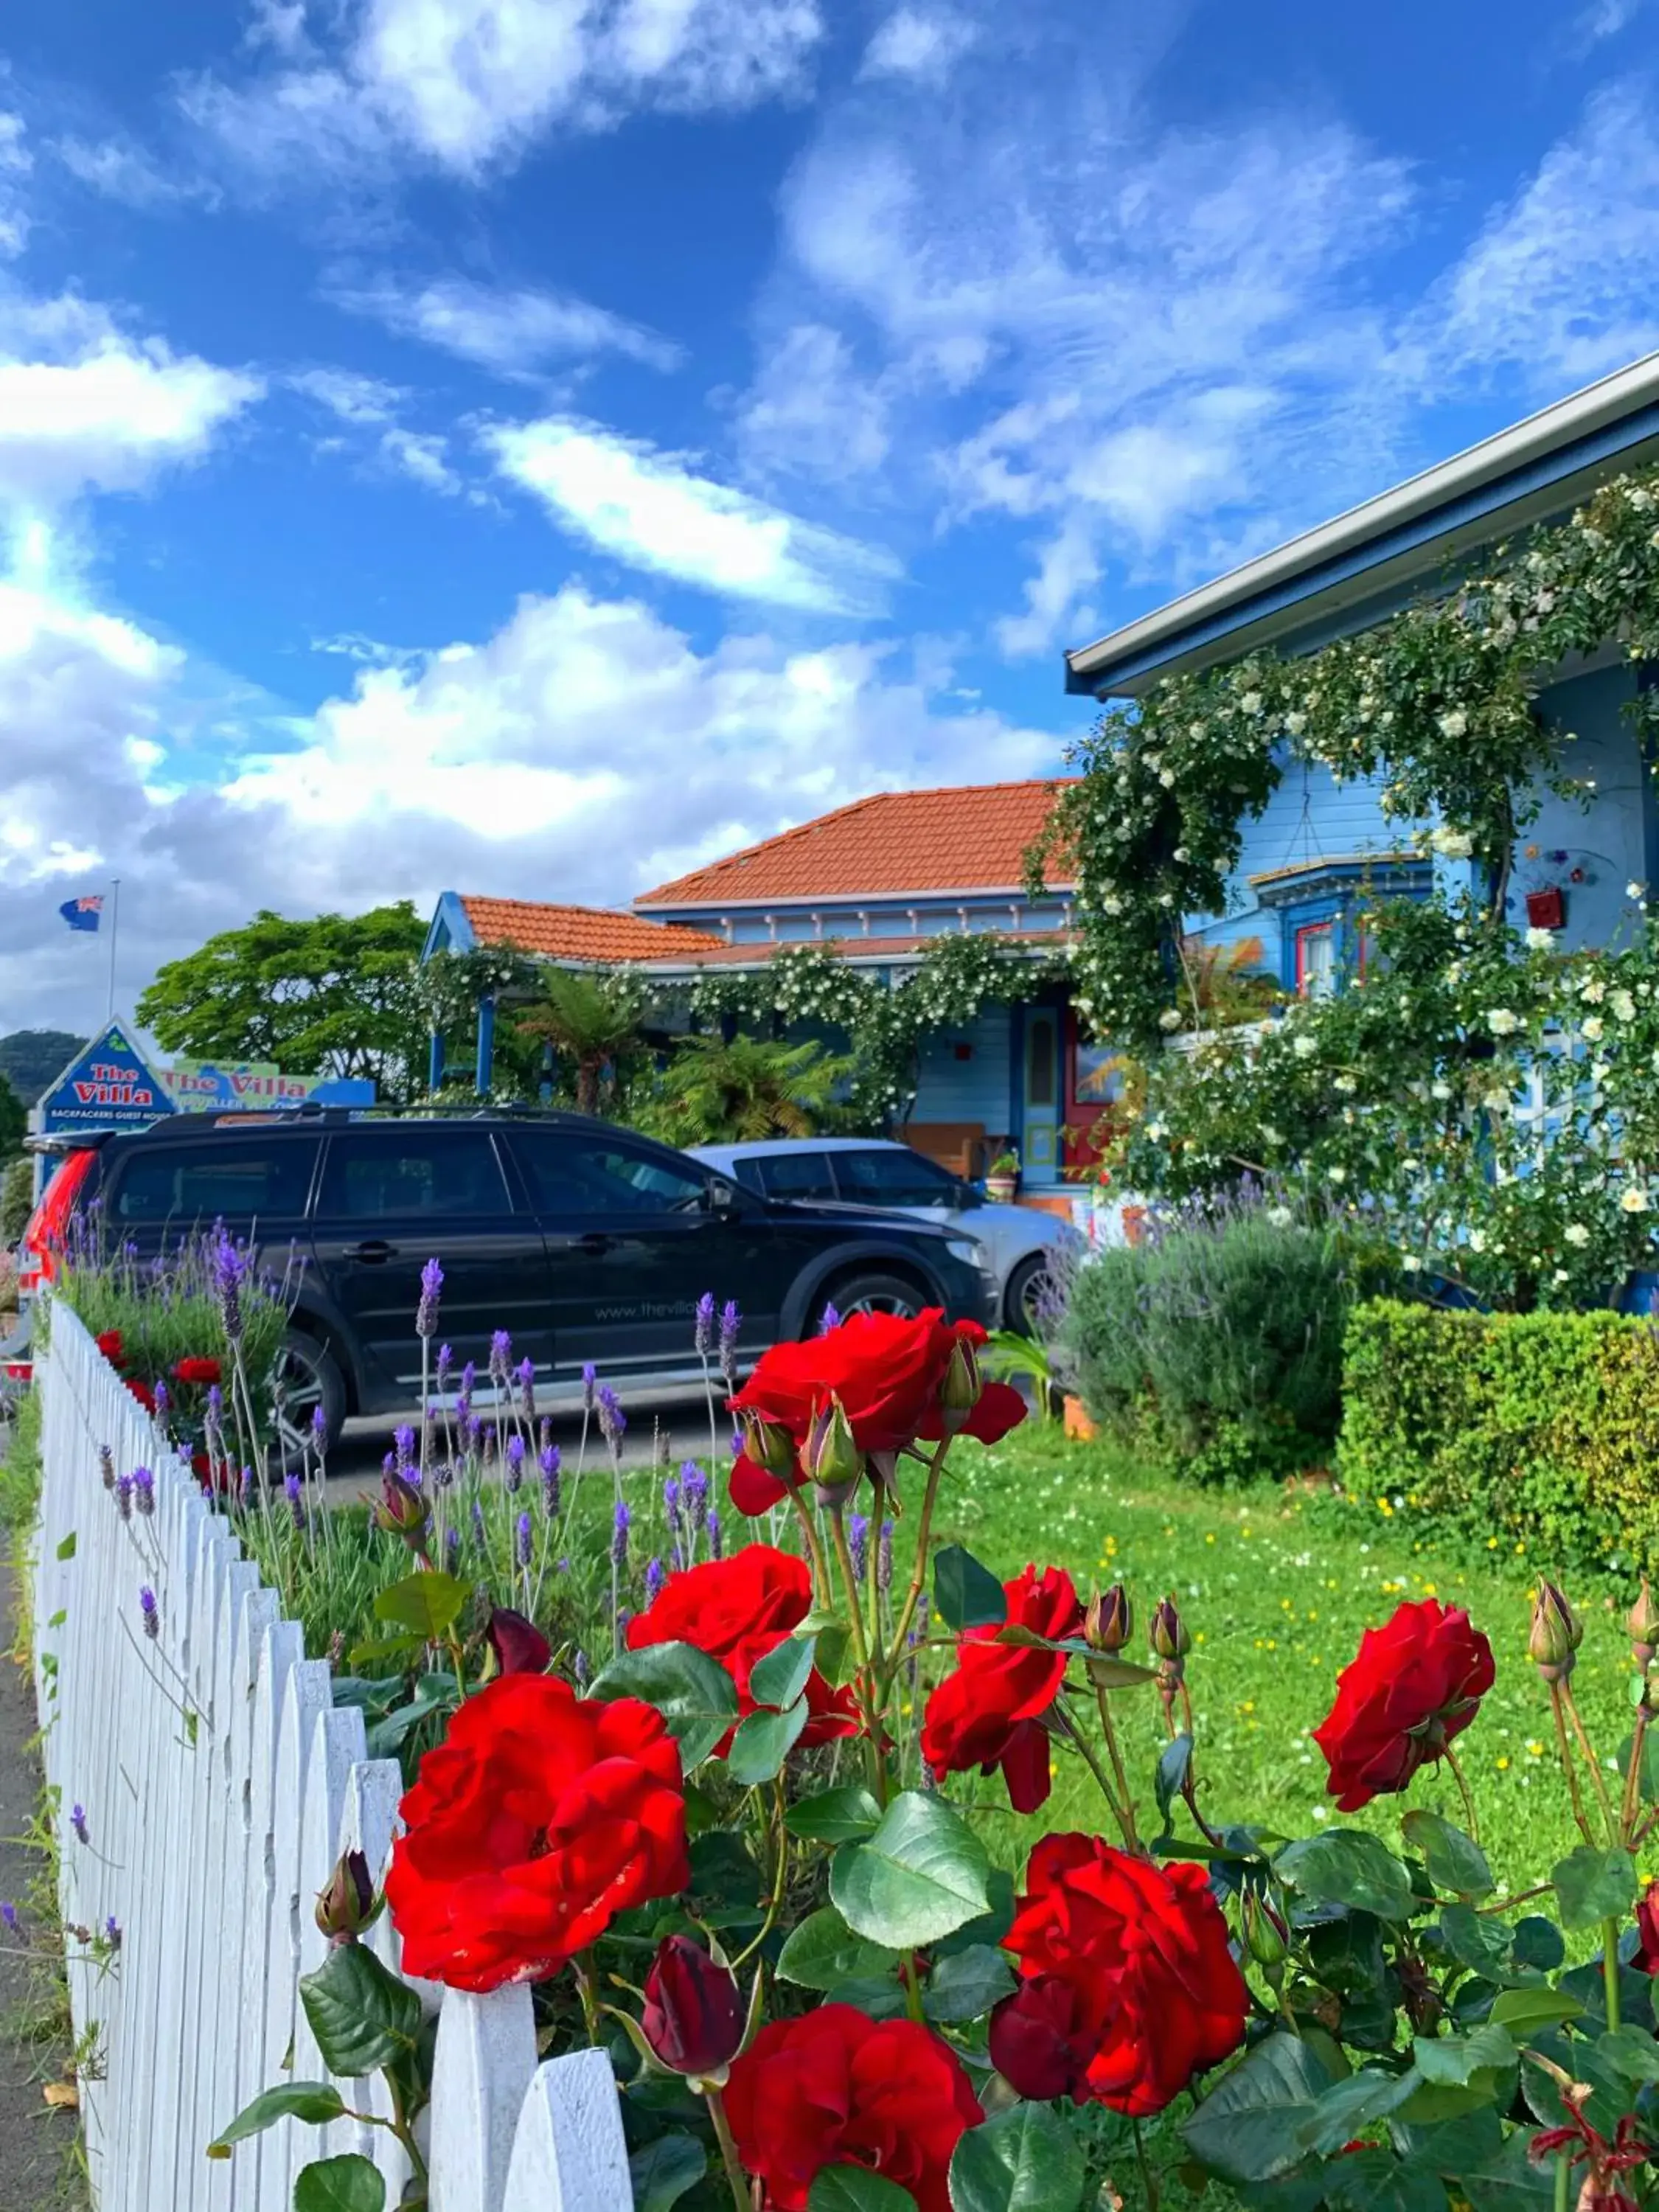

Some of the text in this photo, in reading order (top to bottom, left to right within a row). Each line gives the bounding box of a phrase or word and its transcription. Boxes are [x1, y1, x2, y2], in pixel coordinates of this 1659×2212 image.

[91, 1063, 139, 1082] The
[72, 1082, 152, 1105] Villa
[161, 1071, 307, 1097] The Villa
[116, 1111, 142, 1120] GUEST
[594, 1300, 698, 1322] www.thevilla
